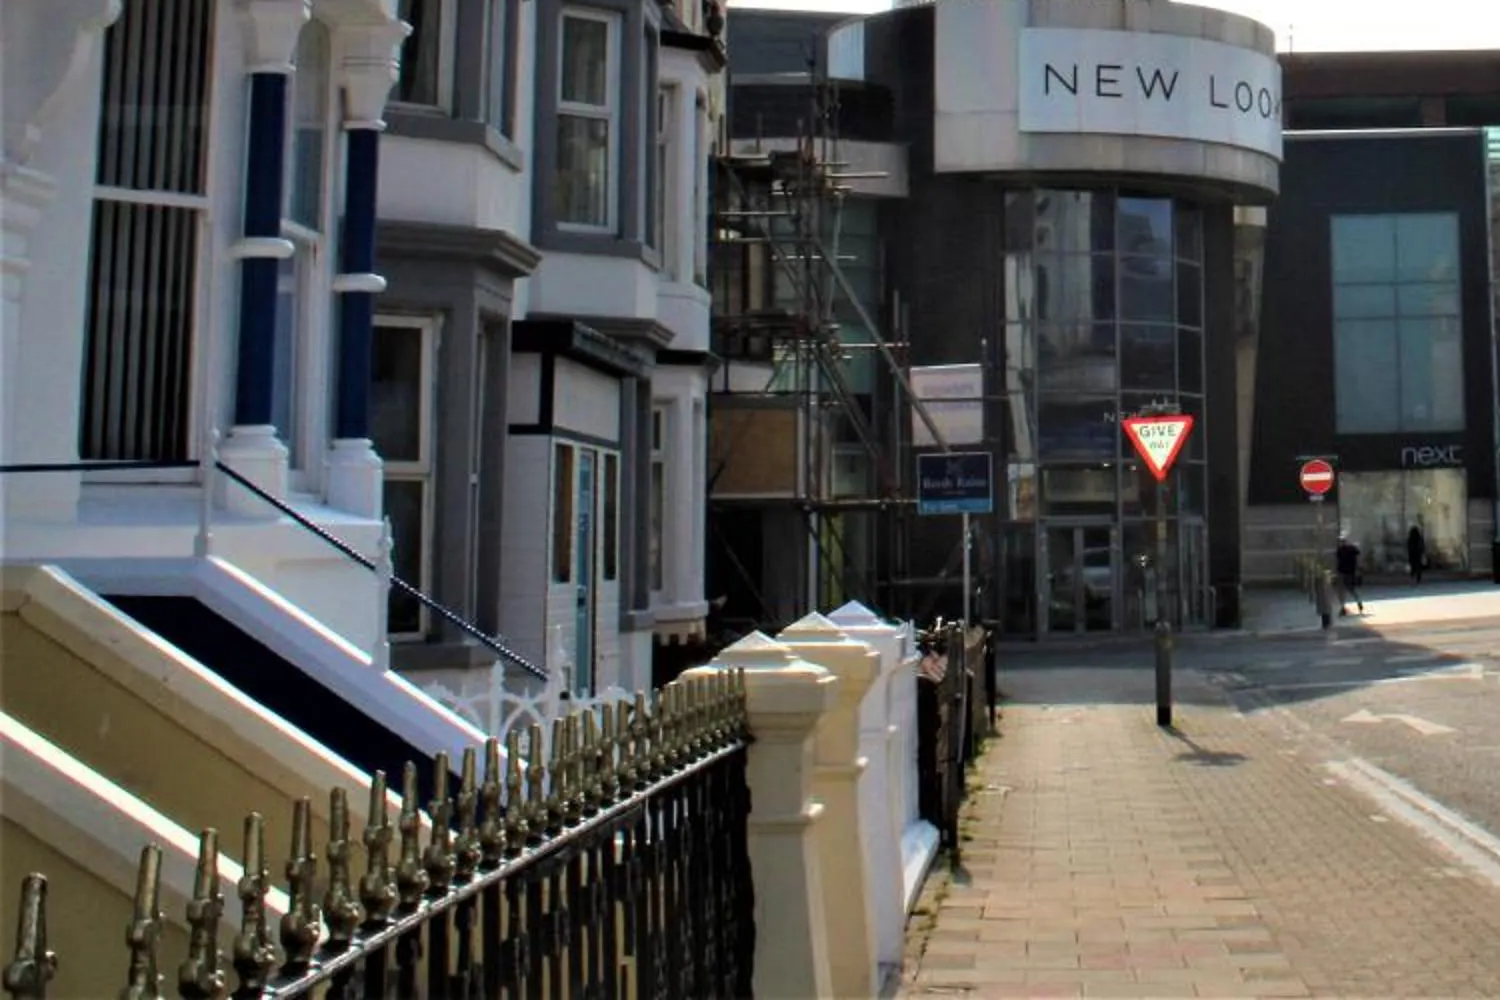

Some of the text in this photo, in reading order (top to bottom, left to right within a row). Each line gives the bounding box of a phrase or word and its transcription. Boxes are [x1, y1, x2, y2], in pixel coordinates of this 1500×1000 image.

[1045, 63, 1179, 101] NEW
[1139, 423, 1177, 438] GIVE
[1401, 445, 1463, 467] next
